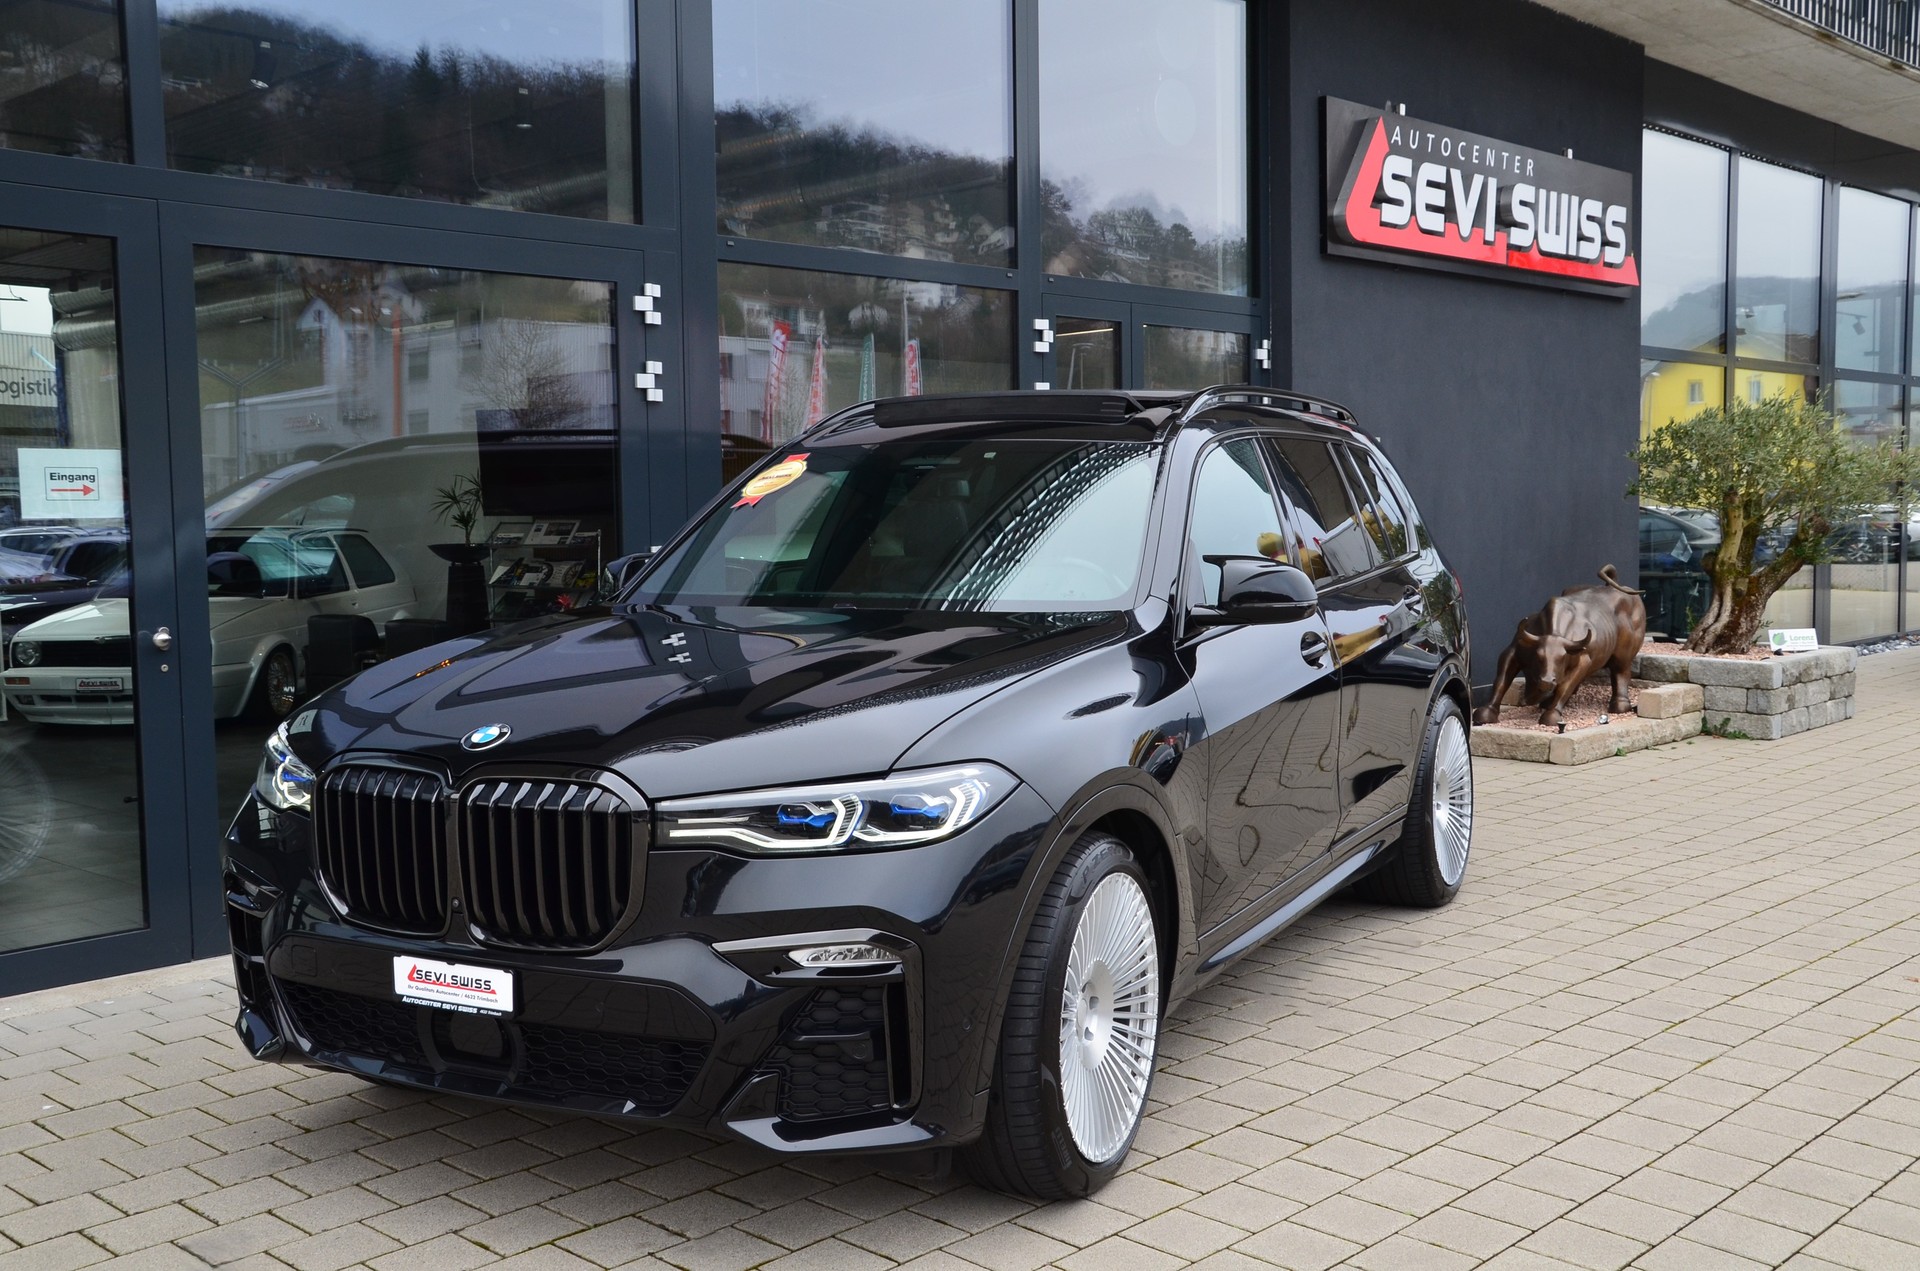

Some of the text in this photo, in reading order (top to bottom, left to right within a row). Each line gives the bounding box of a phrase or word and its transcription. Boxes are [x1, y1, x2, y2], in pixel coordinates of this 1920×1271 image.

[1391, 126, 1534, 177] AUTOCENTER
[1380, 154, 1627, 264] SEVI SWISS
[50, 472, 96, 483] Eingang
[415, 969, 492, 991] SEVI SWISS
